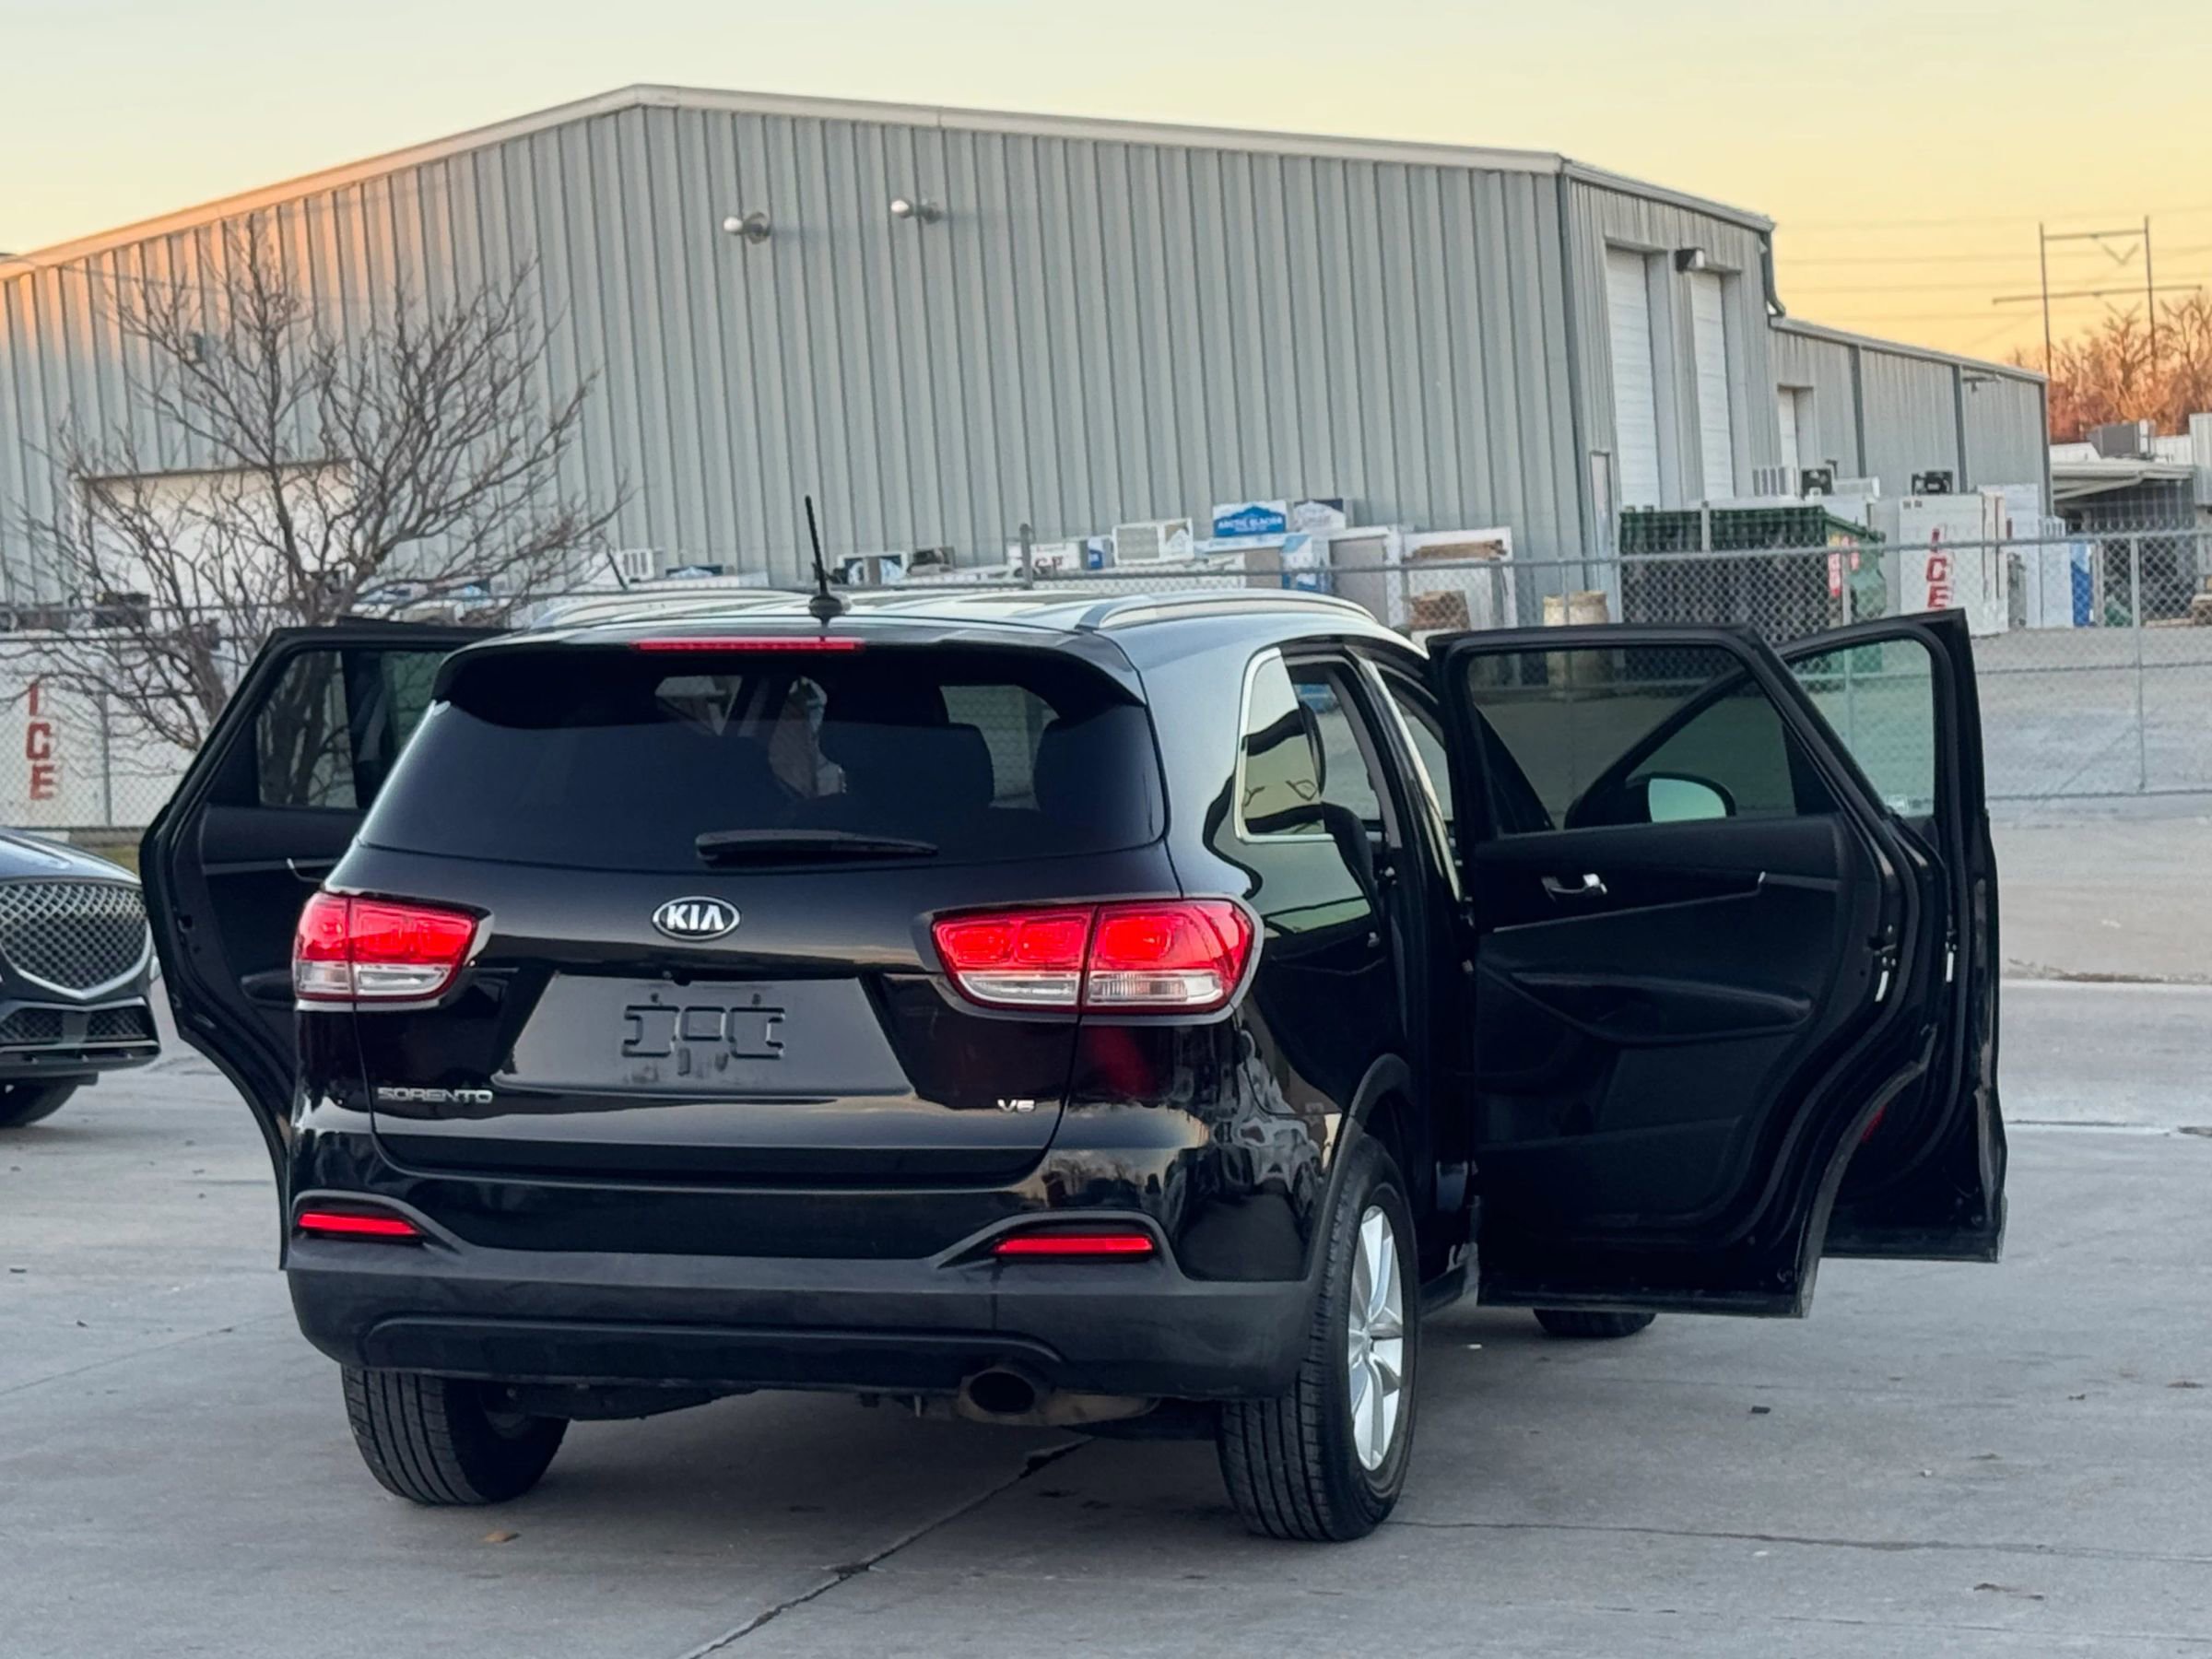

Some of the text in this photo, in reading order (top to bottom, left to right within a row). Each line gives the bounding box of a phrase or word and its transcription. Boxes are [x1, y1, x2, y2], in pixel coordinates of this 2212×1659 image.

[1926, 527, 1948, 609] ICE
[26, 683, 53, 800] ICE
[666, 904, 725, 931] KIA
[377, 1087, 493, 1103] SORENTO
[997, 1099, 1035, 1112] V6
